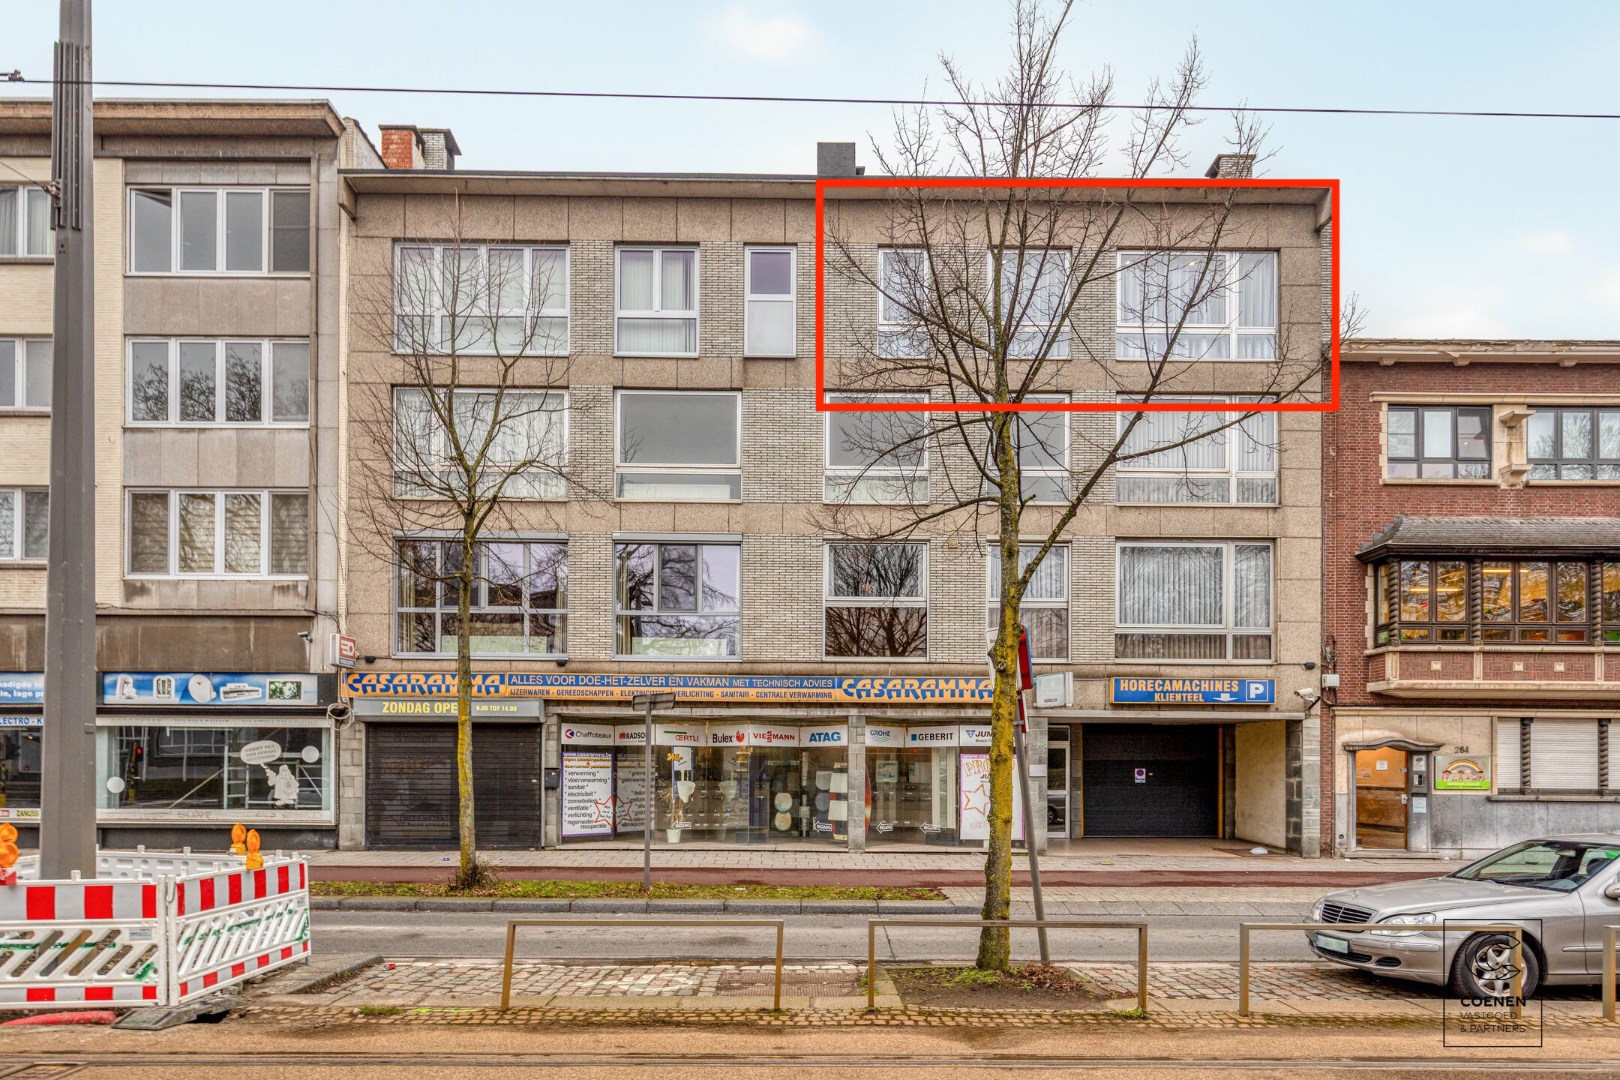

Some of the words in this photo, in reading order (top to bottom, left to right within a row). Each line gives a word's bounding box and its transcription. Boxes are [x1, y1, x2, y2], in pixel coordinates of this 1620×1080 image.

[347, 673, 500, 695] CASARAMMA
[511, 676, 543, 685] ALLES
[547, 676, 576, 685] VOOR
[578, 676, 666, 686] DOE-HET-ZELVER
[669, 677, 684, 687] EN
[686, 677, 730, 687] VAKMAN
[733, 679, 750, 687] MET
[752, 679, 801, 688] TECHNISCH
[803, 680, 833, 688] ADVIES
[1120, 680, 1239, 693] HORECAMACHINES
[673, 690, 714, 698] VERLICHTING
[756, 691, 788, 699] CENTRALE
[841, 679, 993, 700] CASARAMMA
[1250, 683, 1265, 699] P
[1154, 692, 1205, 702] KLIENTEEL
[382, 702, 430, 714] ZONDAG
[434, 702, 459, 714] OPE
[575, 731, 612, 739] Chaffoteaux
[626, 731, 646, 739] RADSO
[712, 733, 733, 743] Bulex
[752, 730, 795, 743] VIESSMANN
[809, 732, 842, 743] ATAG
[918, 732, 954, 741] GEBERIT
[1454, 746, 1469, 754] 264
